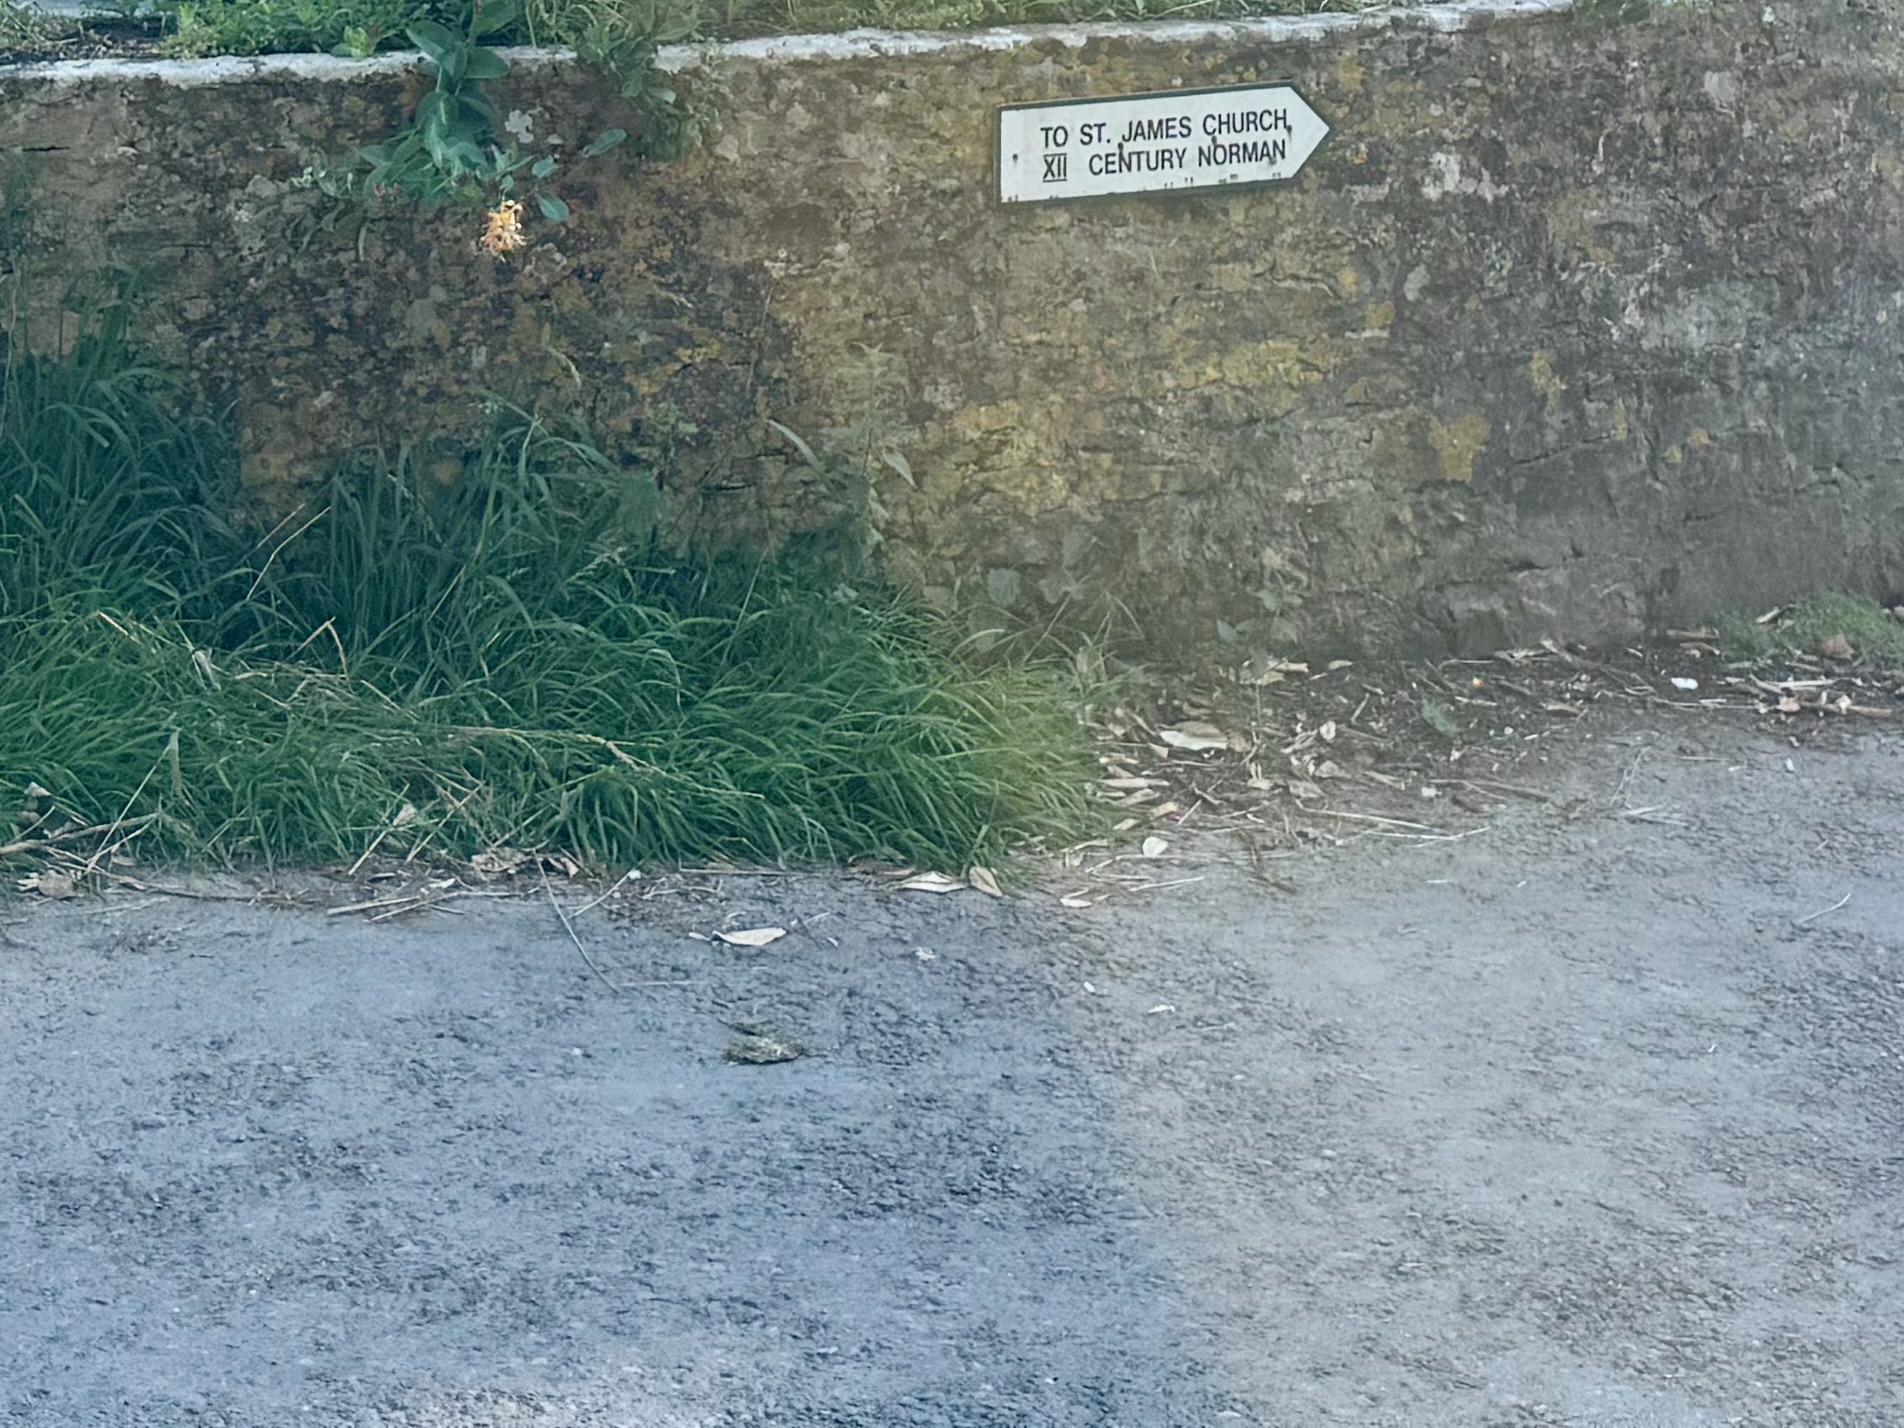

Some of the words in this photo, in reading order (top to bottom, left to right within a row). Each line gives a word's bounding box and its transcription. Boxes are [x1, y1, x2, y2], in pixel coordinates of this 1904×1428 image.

[1040, 125, 1068, 149] TO
[1080, 122, 1111, 146] ST.
[1122, 115, 1192, 143] JAMES
[1202, 108, 1287, 137] CHURCH
[1042, 152, 1068, 183] XII
[1088, 147, 1187, 176] CENTURY
[1198, 138, 1286, 167] NORMAN
